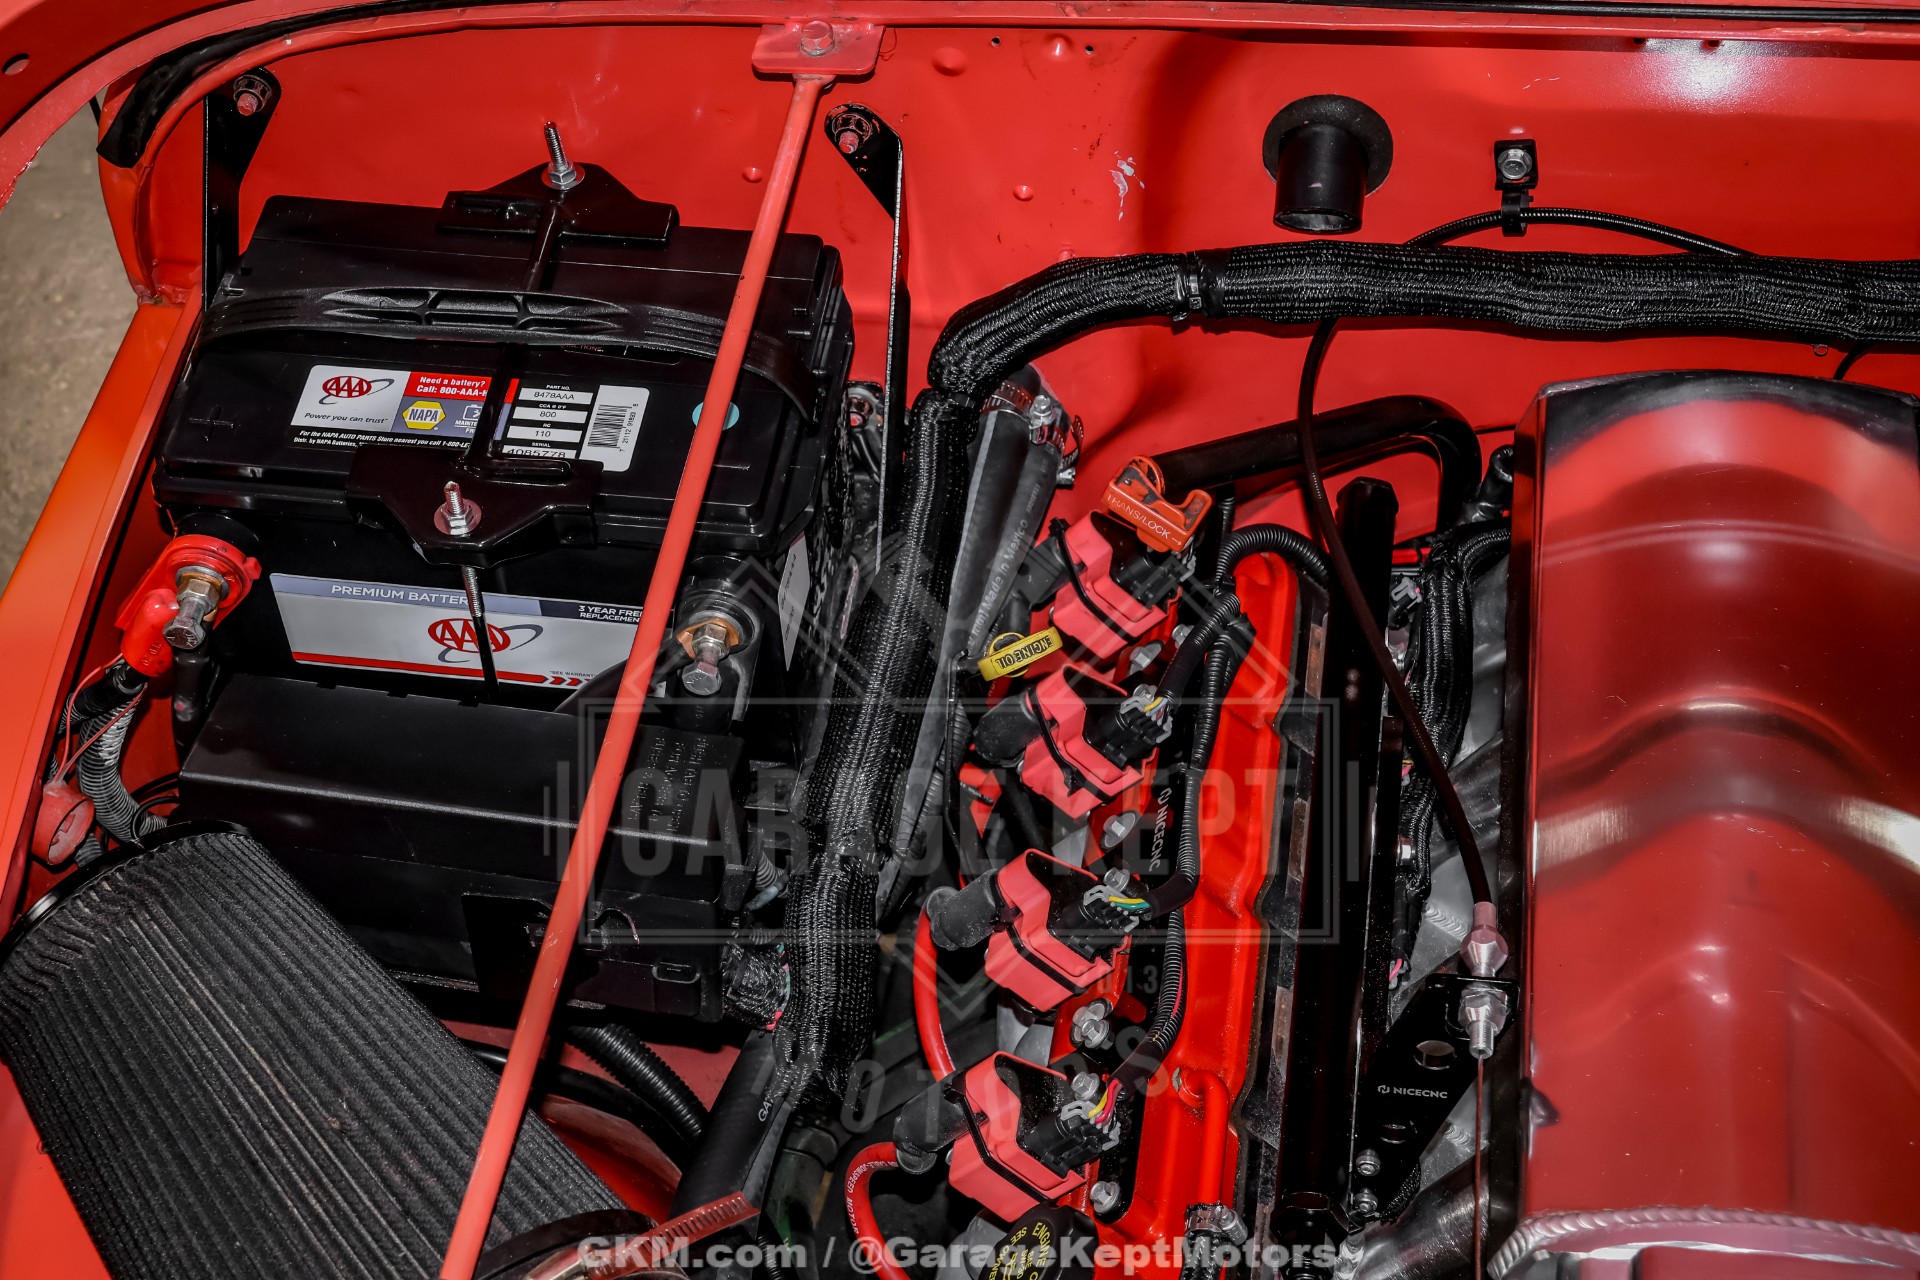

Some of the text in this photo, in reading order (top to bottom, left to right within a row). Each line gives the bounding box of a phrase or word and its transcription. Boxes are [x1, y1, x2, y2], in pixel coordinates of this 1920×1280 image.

[323, 376, 372, 398] AAA
[416, 385, 437, 393] Call:
[420, 376, 441, 384] Need
[450, 379, 486, 388] battery?
[533, 391, 574, 400] 8478AAA
[304, 412, 332, 420] Power
[408, 408, 439, 423] NAPA
[507, 448, 566, 458] 4085778
[1107, 494, 1172, 539] TRANS/LOCK
[983, 576, 1002, 604] Made
[1003, 518, 1029, 566] Mexico
[331, 584, 405, 600] PREMIUM
[587, 606, 617, 616] YEAR
[994, 635, 1054, 670] ENGINE OIL
[1148, 804, 1169, 872] NICECNC
[1393, 1086, 1448, 1099] NICECNC
[1010, 1226, 1028, 1246] SEE
[1031, 1222, 1052, 1268] ENGINE
